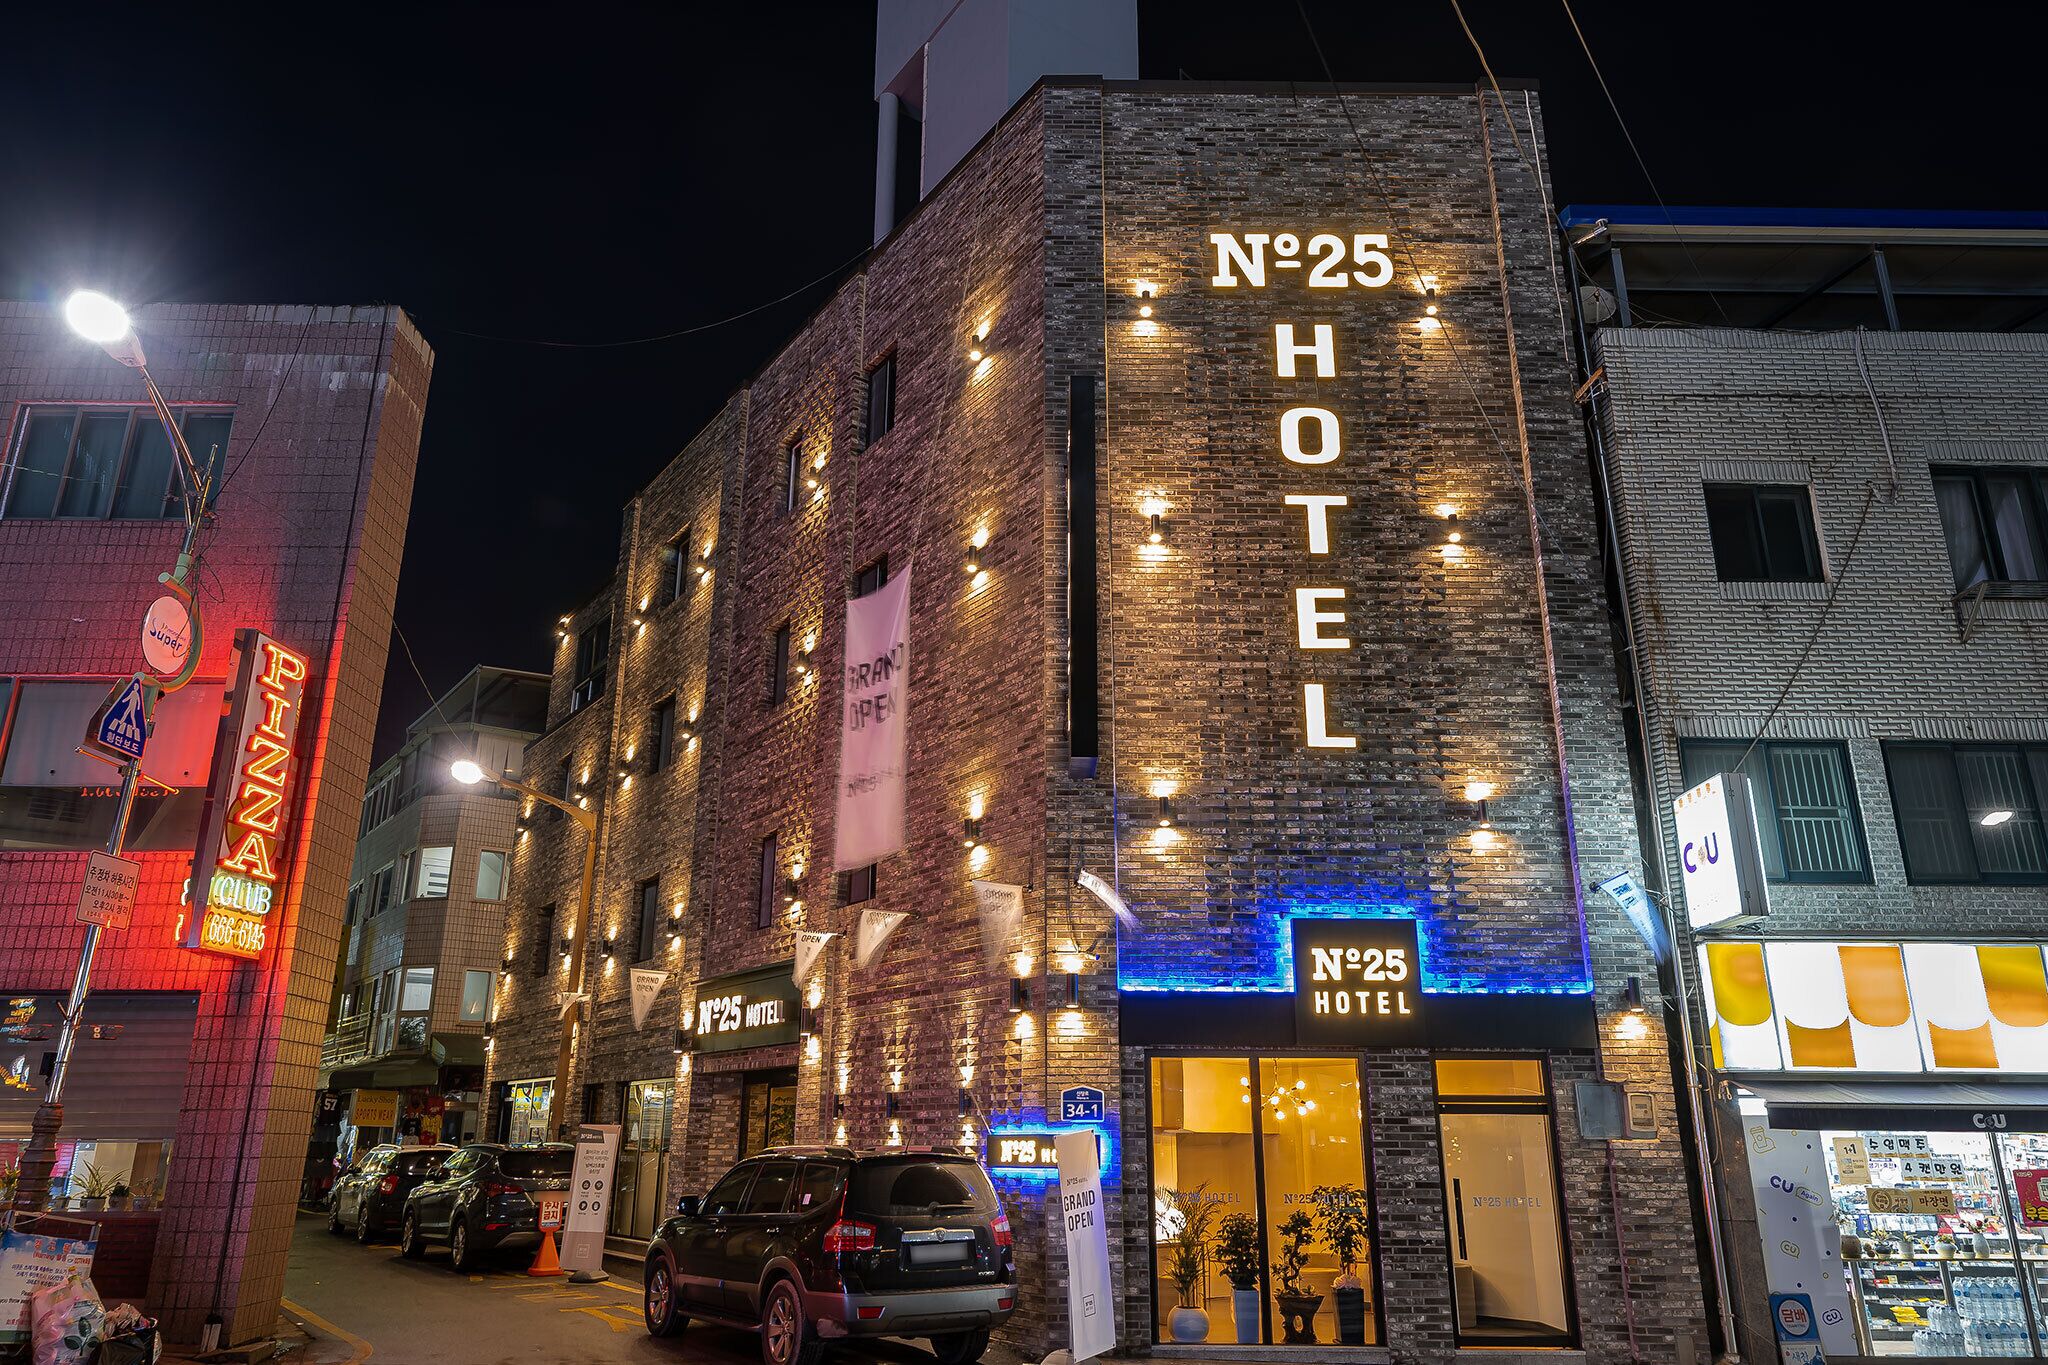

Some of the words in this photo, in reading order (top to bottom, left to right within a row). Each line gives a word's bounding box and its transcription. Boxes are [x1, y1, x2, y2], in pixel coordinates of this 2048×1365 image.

[1273, 323, 1357, 749] HOTEL
[150, 618, 183, 651] Super
[849, 686, 897, 731] OPEN
[107, 731, 140, 753] 횡단보도
[222, 643, 306, 880] PIZZA
[1683, 832, 1719, 873] CU
[801, 934, 822, 943] OPEN
[636, 975, 660, 985] GRAND
[636, 984, 655, 993] OPEN
[1314, 990, 1411, 1014] HOTEL
[745, 1000, 783, 1028] HOTEL
[324, 1098, 338, 1111] 57
[1066, 1103, 1099, 1118] 34-1
[1972, 1113, 2007, 1129] CU
[1843, 1143, 1857, 1155] 1+1
[1770, 1176, 1795, 1194] CU
[1063, 1189, 1096, 1212] GRAND
[1204, 1192, 1241, 1203] HOTEL
[1505, 1197, 1542, 1208] HOTEL
[1801, 1190, 1819, 1202] Again
[1919, 1195, 1949, 1208] 마장면
[543, 1210, 559, 1221] 금지
[1068, 1210, 1094, 1231] OPEN
[1783, 1243, 1797, 1254] CU
[1781, 1308, 1808, 1323] 담배
[1825, 1312, 1838, 1322] CU
